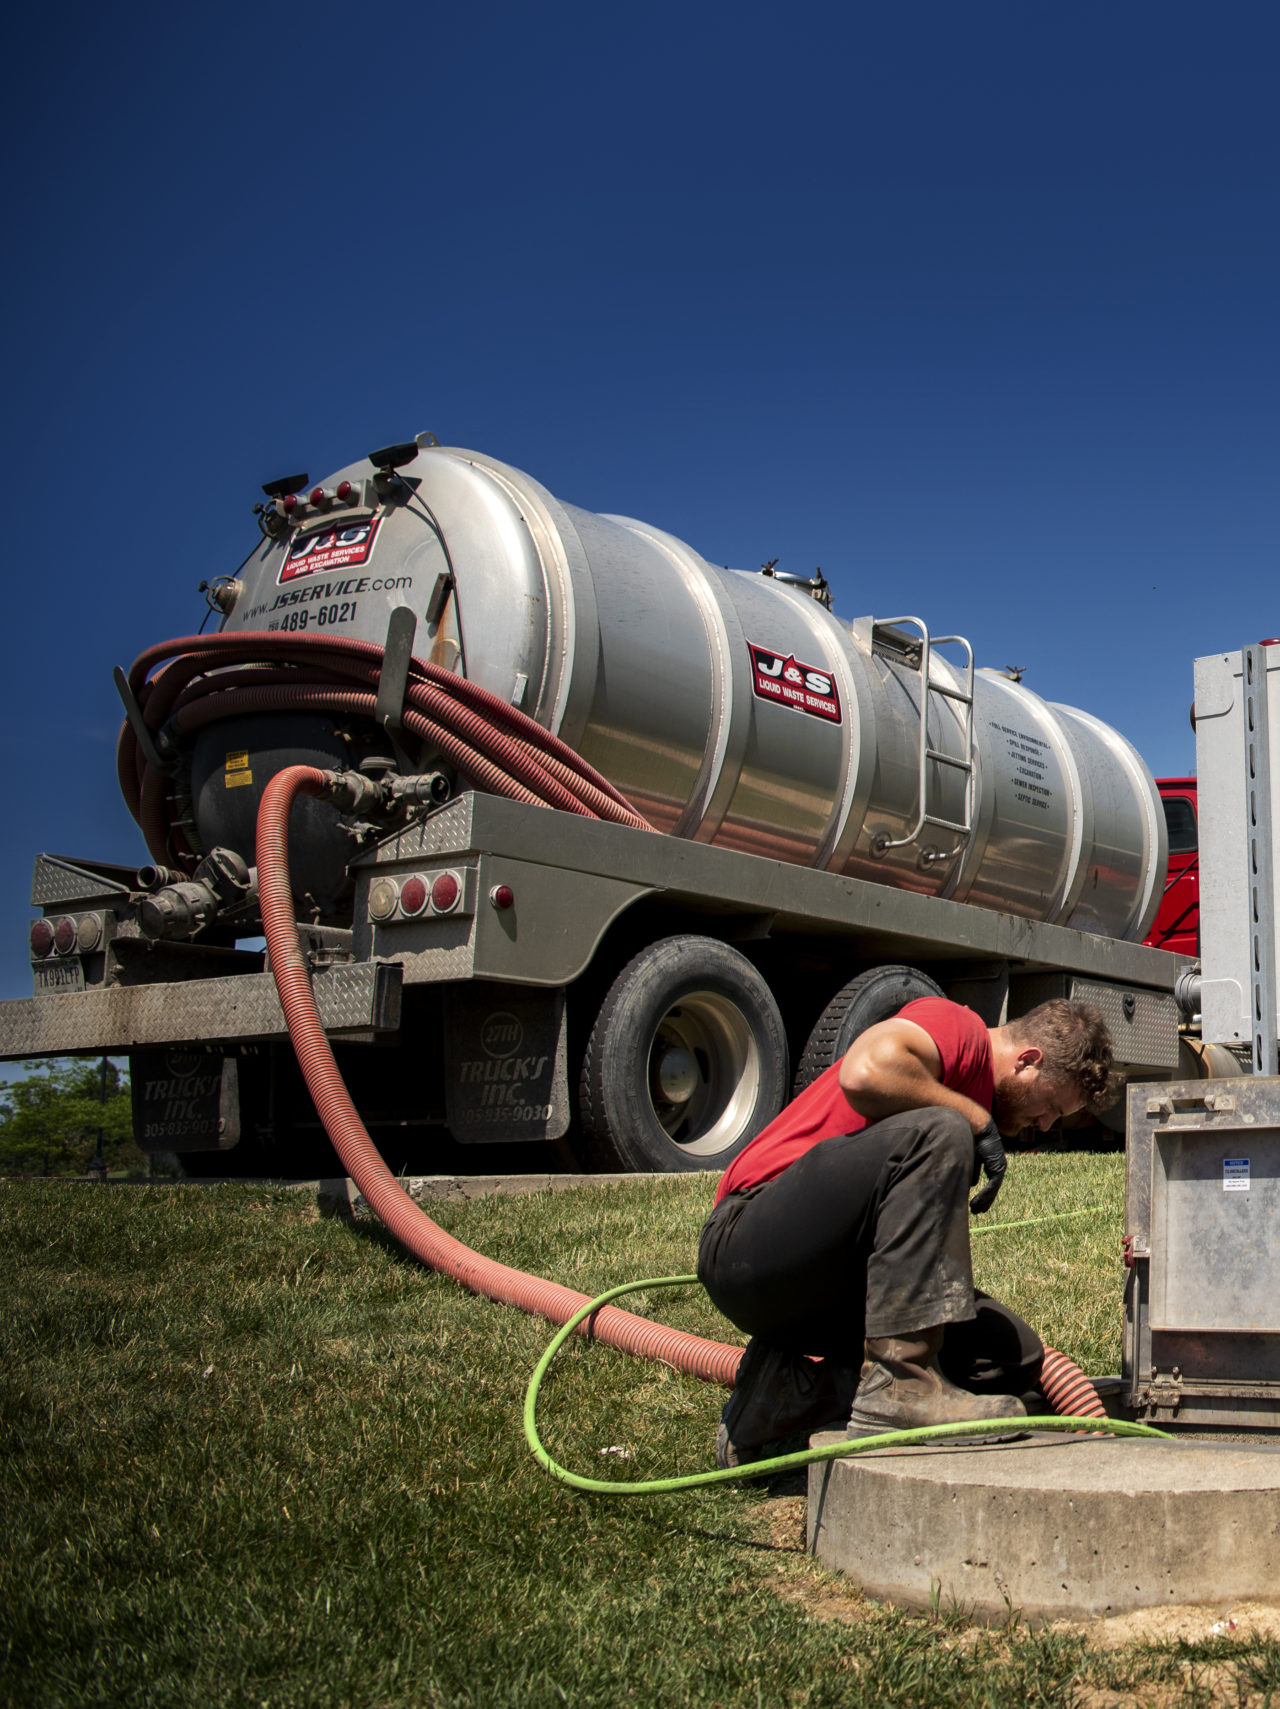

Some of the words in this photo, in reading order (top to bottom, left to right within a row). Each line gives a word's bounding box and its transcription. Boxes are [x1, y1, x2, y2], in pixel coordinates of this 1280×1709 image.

[291, 525, 370, 559] J&S
[286, 559, 306, 571] LIQUID
[308, 552, 330, 563] WASTE
[331, 546, 365, 558] SERVICES
[295, 564, 308, 575] AND
[310, 556, 350, 570] EXCAVATION
[242, 576, 413, 622] www.JSSERVICE.com
[280, 601, 357, 632] 489-6021
[758, 658, 831, 695] J&S
[759, 678, 781, 694] LIQUID
[782, 686, 804, 703] WASTE
[806, 694, 836, 714] SERVICES
[1019, 767, 1042, 781] EXCAVATION
[1027, 757, 1045, 769] SERVICES
[1014, 778, 1028, 789] SEWER
[1028, 783, 1050, 796] INSPECTION
[1018, 793, 1031, 804] SEPTIC
[1032, 798, 1048, 809] SERVICE
[486, 1024, 519, 1042] 27TH
[459, 1056, 549, 1082] TRUCK'S
[144, 1075, 219, 1101] TRUCK'S
[480, 1082, 526, 1105] INC.
[164, 1098, 202, 1121] INC.
